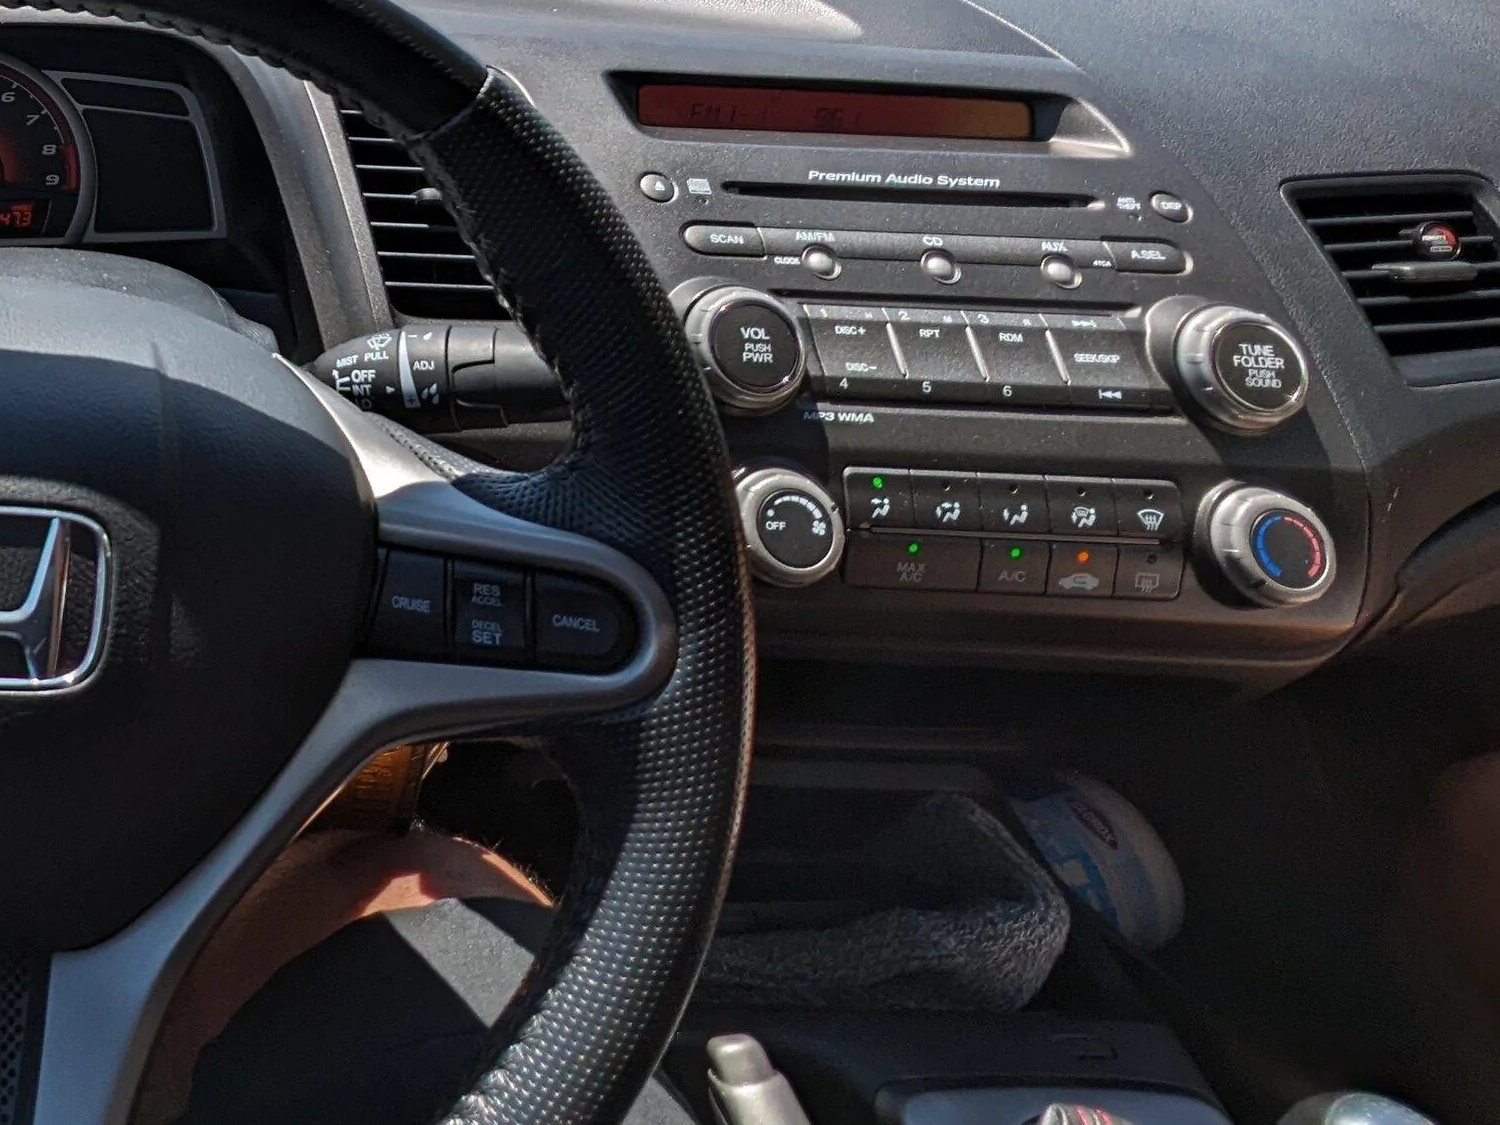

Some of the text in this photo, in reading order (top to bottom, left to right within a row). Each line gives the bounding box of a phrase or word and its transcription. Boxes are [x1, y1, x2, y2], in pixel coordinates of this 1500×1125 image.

[1, 91, 16, 103] 6
[25, 114, 40, 125] 7
[42, 144, 57, 155] 8
[45, 175, 60, 186] 9
[808, 170, 1000, 189] Premium Audio System
[709, 233, 745, 245] SCAN
[795, 231, 836, 242] AM/FM
[923, 235, 943, 247] CD
[1041, 241, 1067, 252] AUX
[898, 311, 910, 321] 2
[977, 313, 989, 324] 3
[740, 327, 770, 340] VOL
[918, 328, 940, 340] RPT
[998, 332, 1023, 343] RDM
[744, 343, 772, 353] PUSH
[1238, 343, 1276, 358] TUNE
[336, 350, 389, 367] MIST PULL
[742, 352, 773, 364] PWR
[1233, 355, 1285, 370] FOLDER
[412, 359, 435, 371] ADJ
[350, 369, 376, 383] OFF
[1248, 369, 1276, 379] PUSH
[839, 378, 849, 390] 4
[921, 381, 932, 394] 5
[1245, 377, 1281, 389] SOUND
[351, 384, 371, 397] INT
[1002, 385, 1013, 397] 6
[803, 411, 875, 423] MP3 WMA
[765, 520, 786, 531] OFF
[998, 569, 1026, 583] A/C
[473, 582, 500, 597] RES
[391, 595, 432, 614] CRUISE
[471, 595, 504, 607] ACCEL
[552, 614, 600, 632] CANCEL
[471, 631, 503, 645] SET
